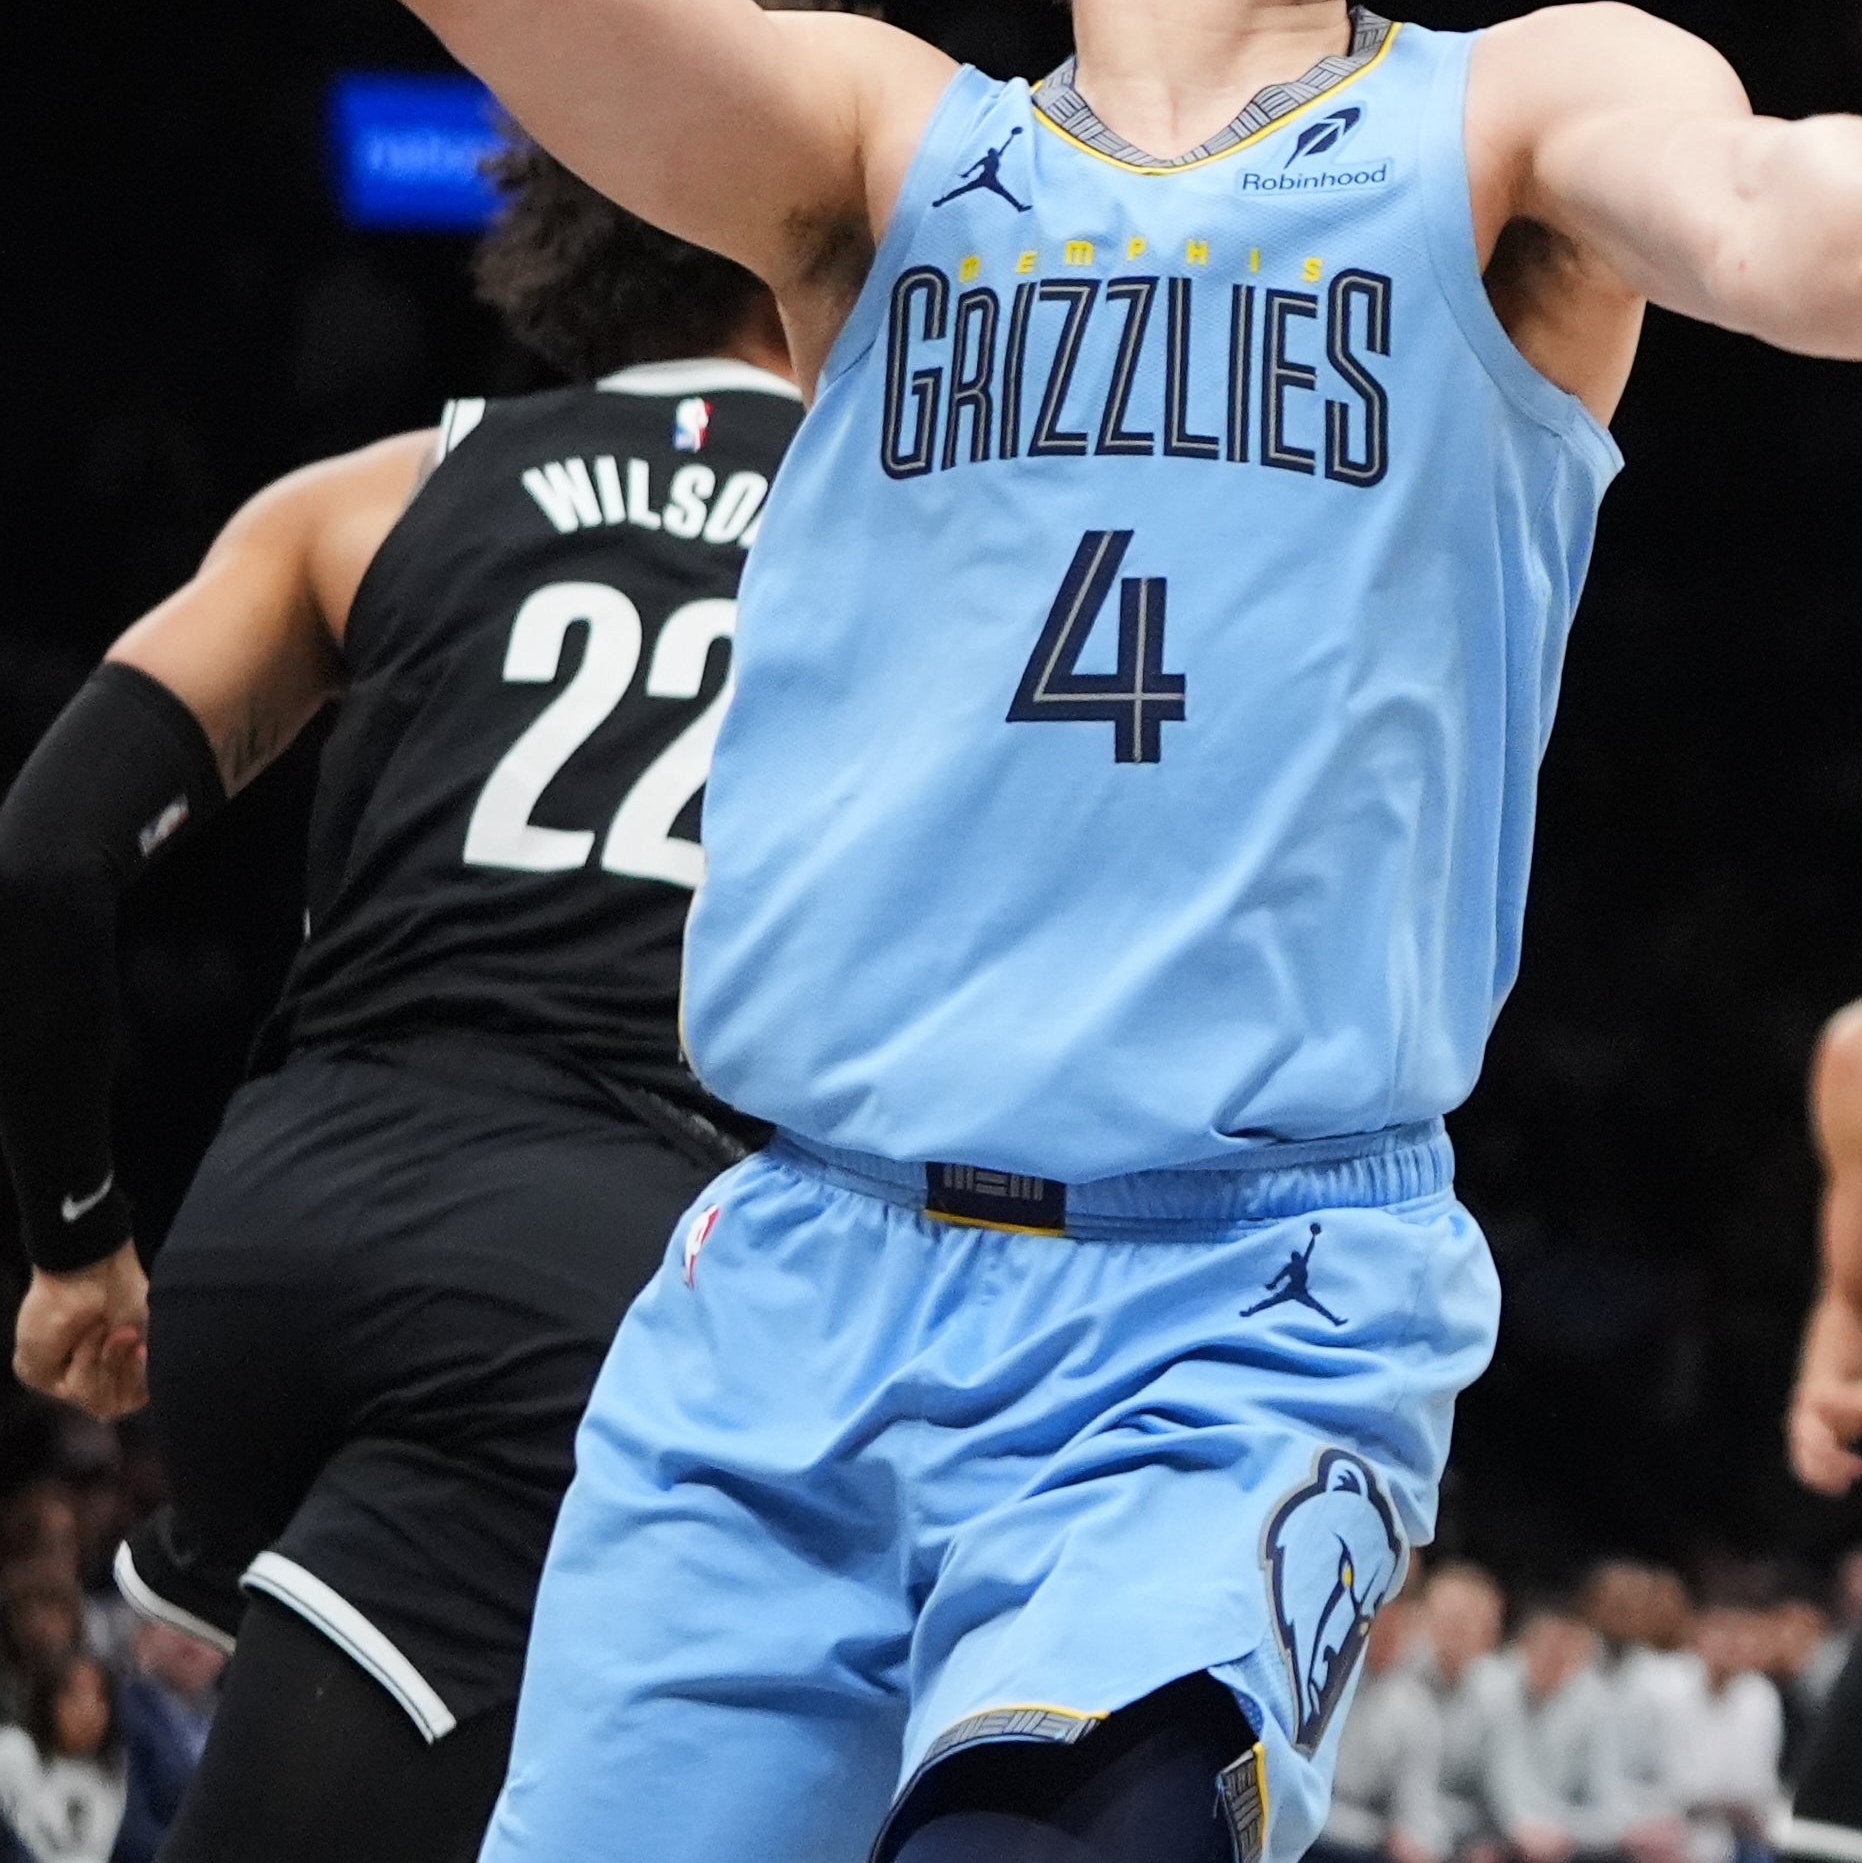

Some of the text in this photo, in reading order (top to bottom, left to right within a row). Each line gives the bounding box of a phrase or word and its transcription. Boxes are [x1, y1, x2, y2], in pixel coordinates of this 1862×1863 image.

[1242, 163, 1386, 190] Robinhood
[958, 236, 1324, 284] MEMPHIS
[880, 264, 1393, 488] GRIZZLIES
[520, 454, 768, 549] WILSO
[1005, 529, 1187, 765] 4
[463, 580, 739, 890] 22
